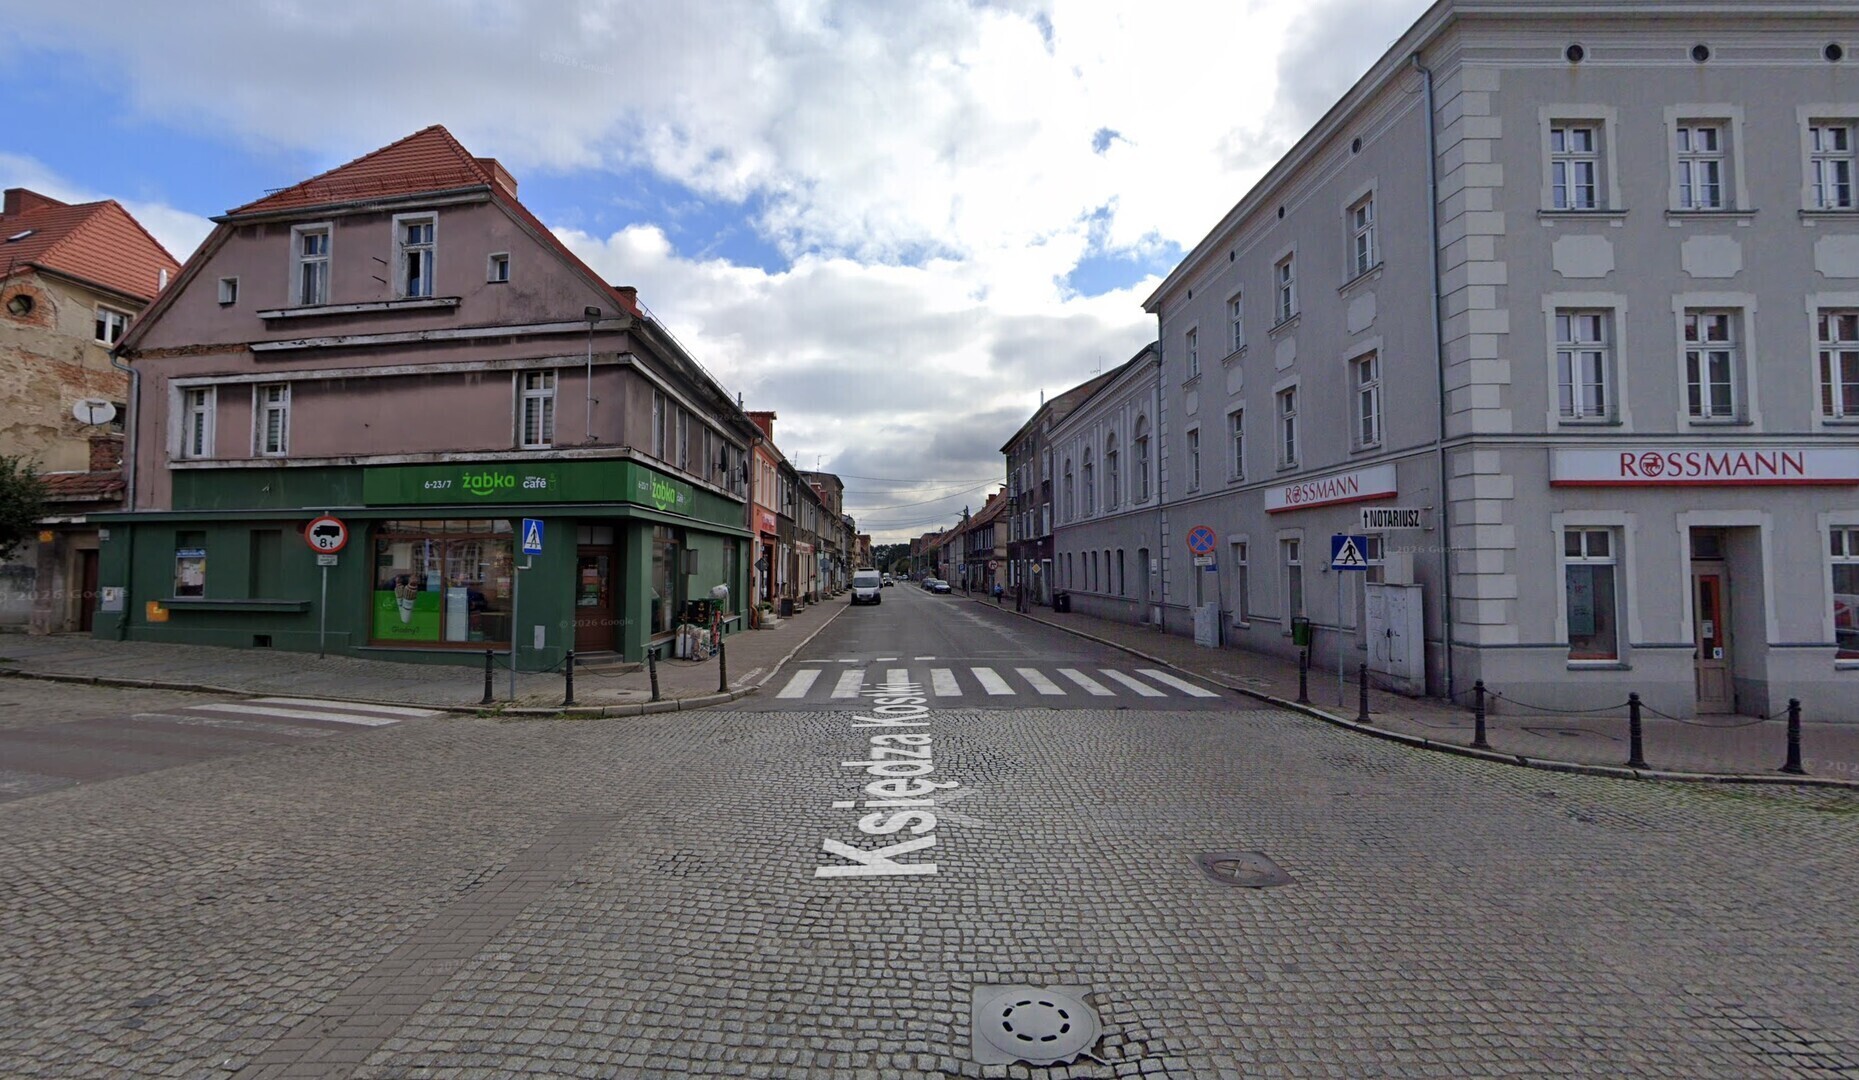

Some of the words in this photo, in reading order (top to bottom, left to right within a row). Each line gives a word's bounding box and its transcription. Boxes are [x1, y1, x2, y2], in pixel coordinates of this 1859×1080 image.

[1620, 451, 1805, 477] ROSSMANN
[462, 472, 515, 489] żabka
[652, 477, 676, 504] żabka
[1285, 475, 1359, 504] ROSSMANN
[1369, 508, 1420, 528] NOTARIUSZ
[320, 538, 327, 548] 8
